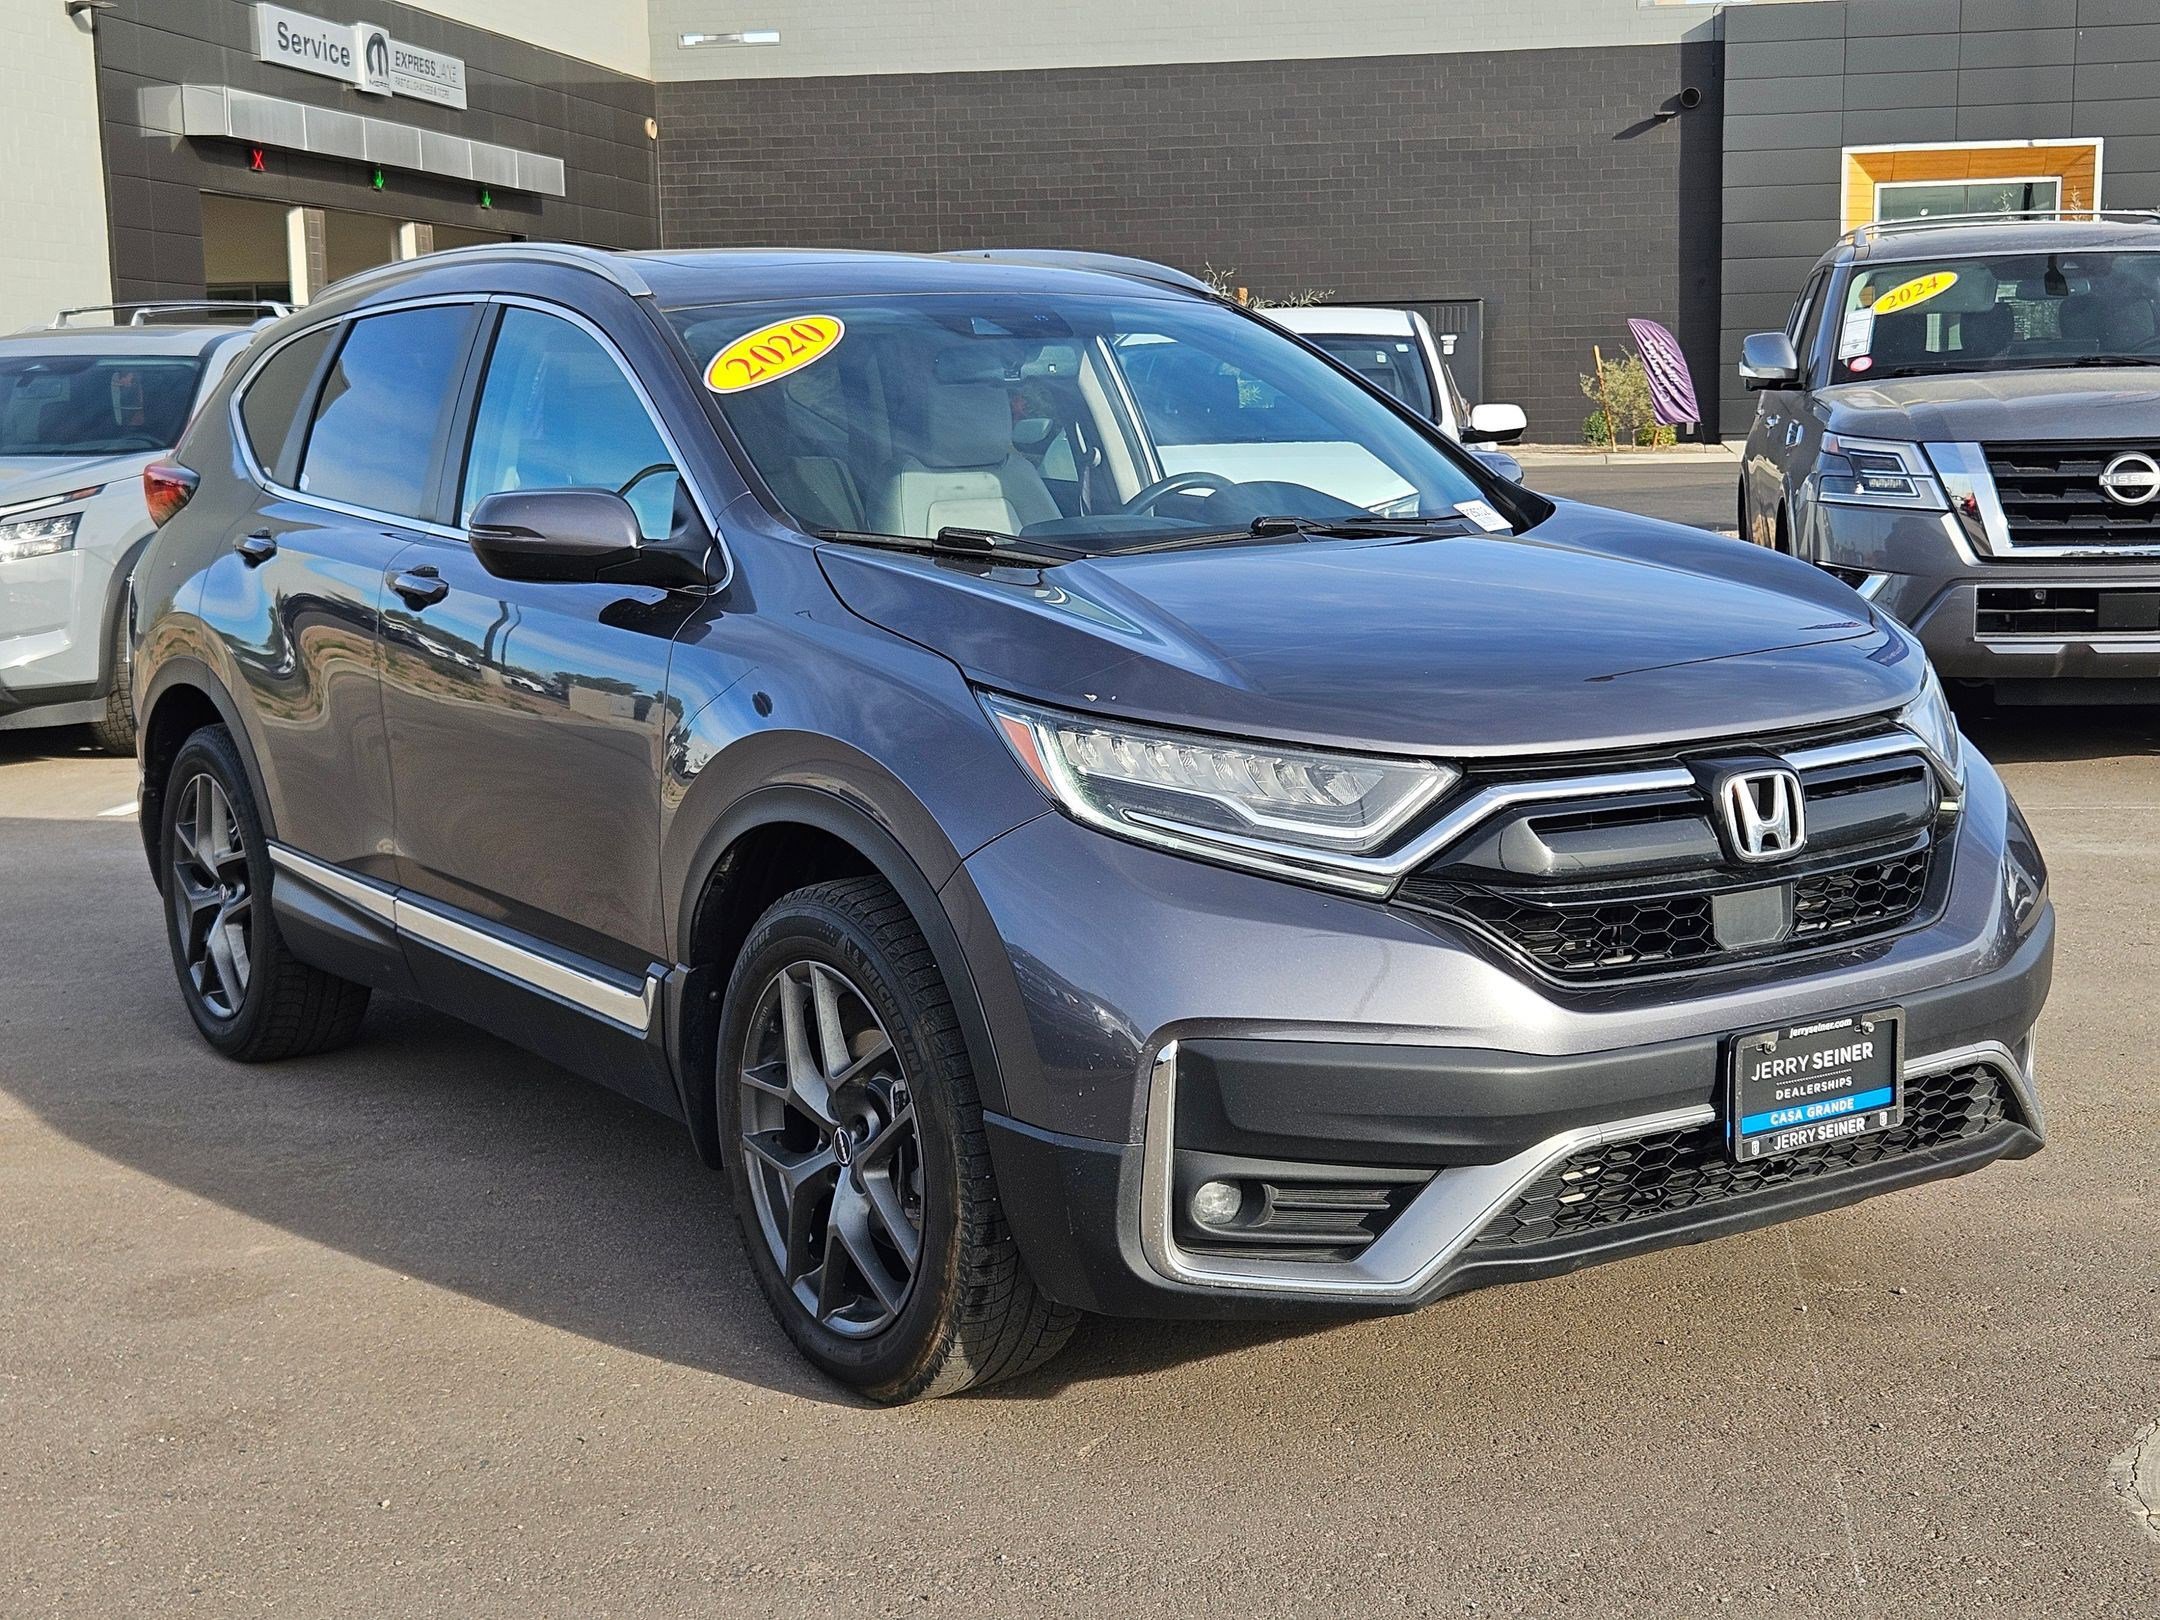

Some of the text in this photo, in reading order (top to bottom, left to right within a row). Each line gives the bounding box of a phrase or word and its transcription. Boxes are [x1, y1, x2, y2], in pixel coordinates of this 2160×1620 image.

[277, 21, 351, 67] Service
[394, 50, 436, 77] EXPRESS
[1886, 276, 1939, 310] 2024
[725, 323, 825, 381] 2020
[860, 960, 921, 1072] MICHELIN
[1789, 1018, 1853, 1039] jerryseiner.com
[1750, 1041, 1874, 1082] JERRY SEINER
[1775, 1076, 1853, 1101] DEALERSHIPS
[1770, 1098, 1855, 1126] CASA GRANDE
[1773, 1117, 1866, 1150] JERRY SEINER
